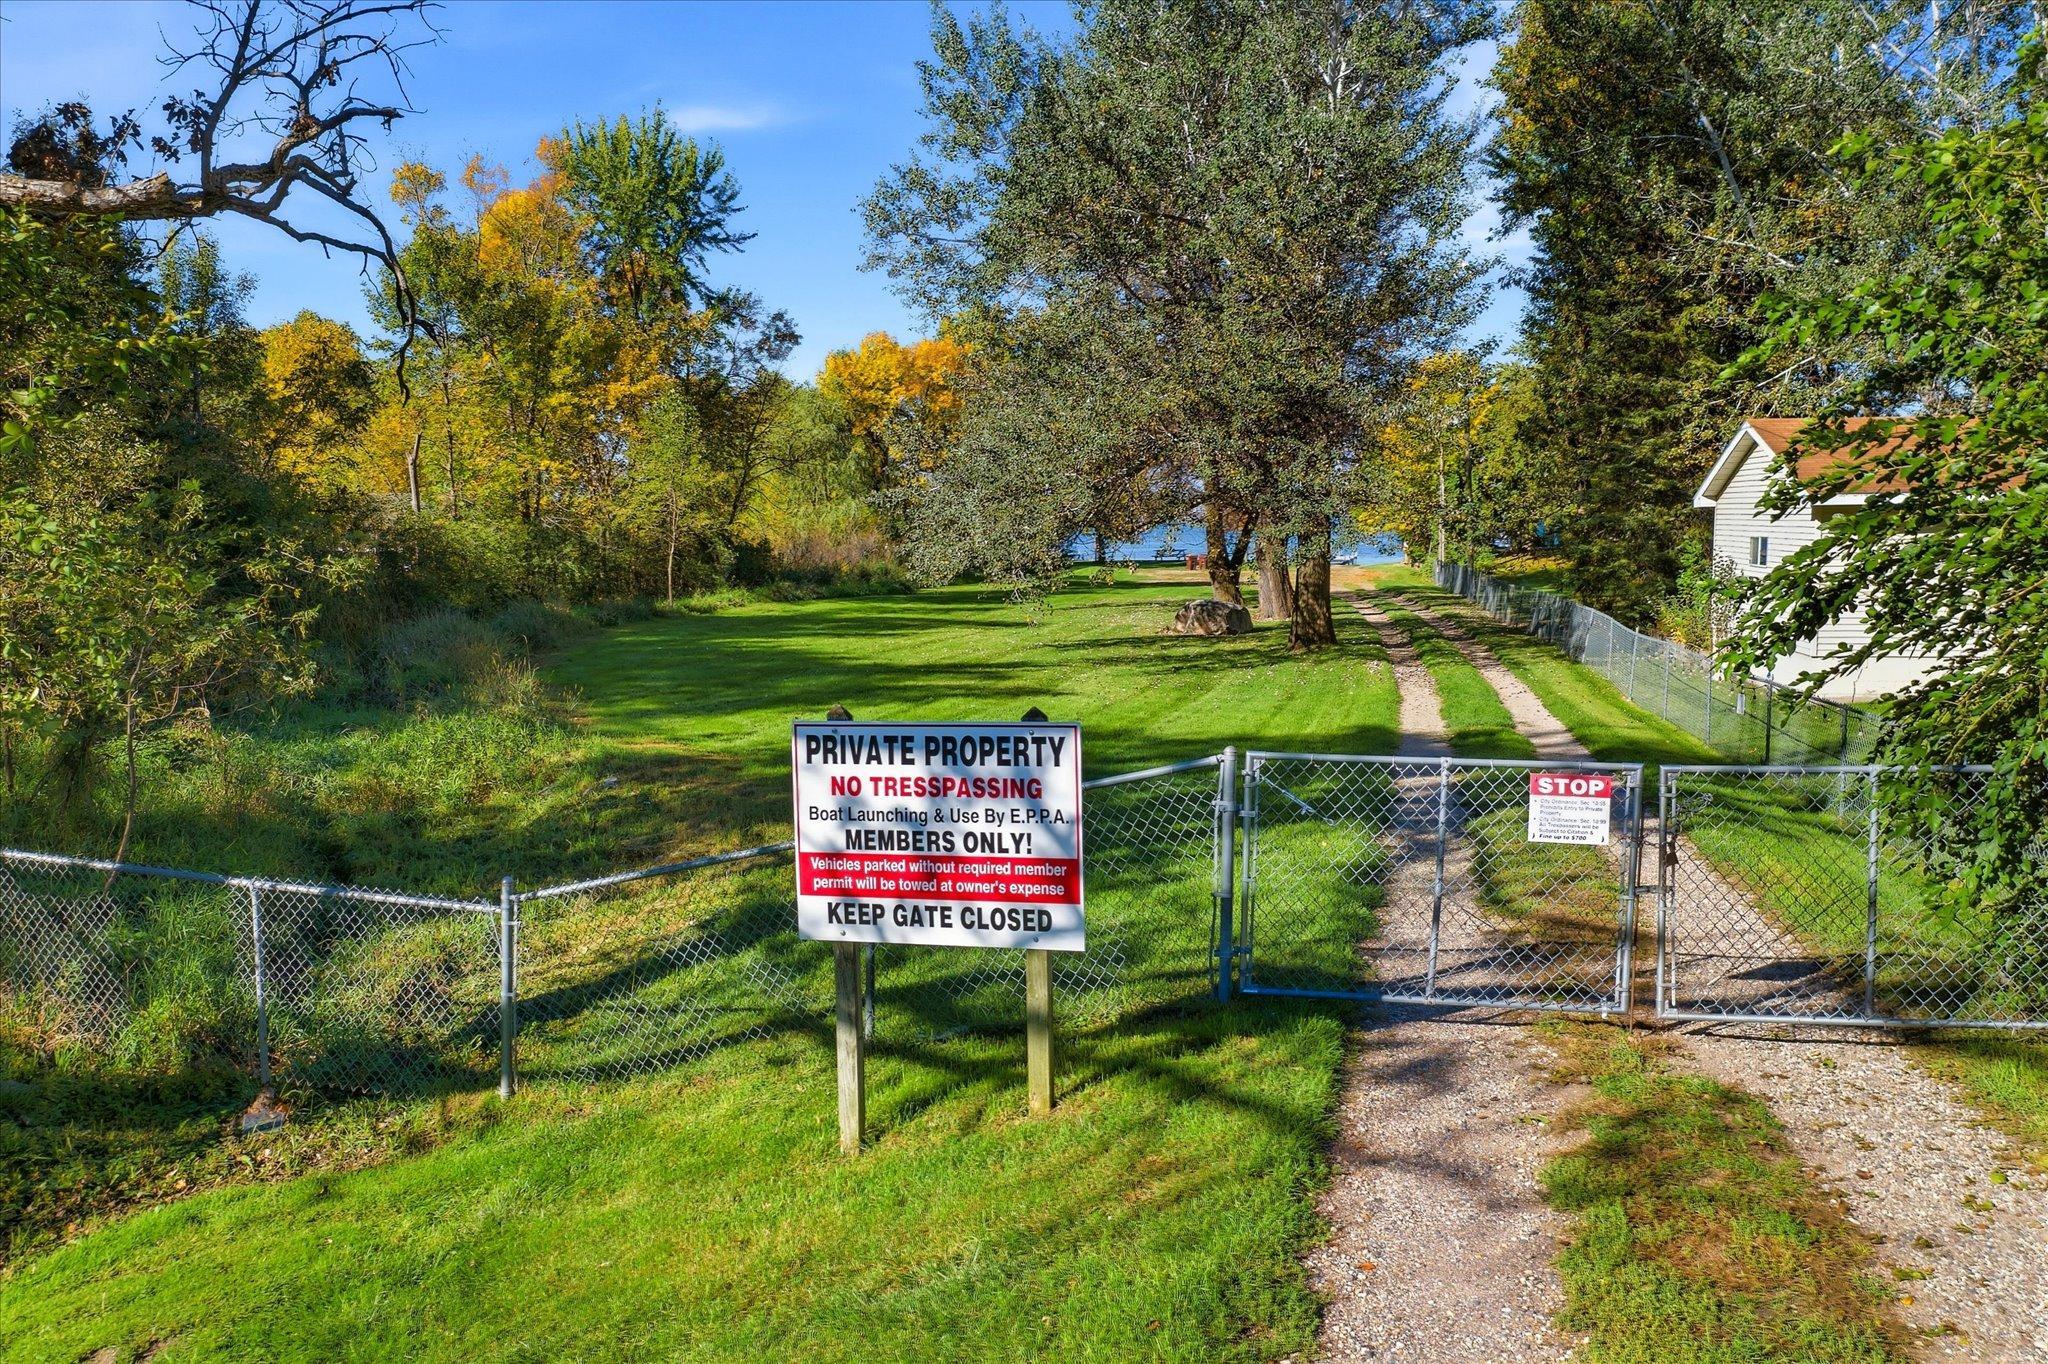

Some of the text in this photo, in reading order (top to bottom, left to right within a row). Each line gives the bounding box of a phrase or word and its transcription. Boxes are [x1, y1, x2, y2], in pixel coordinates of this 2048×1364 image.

[806, 735, 1066, 767] PRIVATE PROPERTY
[831, 776, 1042, 799] NO TRESSPASSING
[1538, 778, 1604, 795] STOP
[810, 806, 1070, 827] Boat Launching & Use By E.P.P.A.
[846, 830, 1032, 854] MEMBERS ONLY!
[810, 857, 1066, 876] Vehicles parked without required member
[814, 876, 1064, 897] permit will be towed at owner's expense
[828, 903, 1052, 932] KEEP GATE CLOSED
